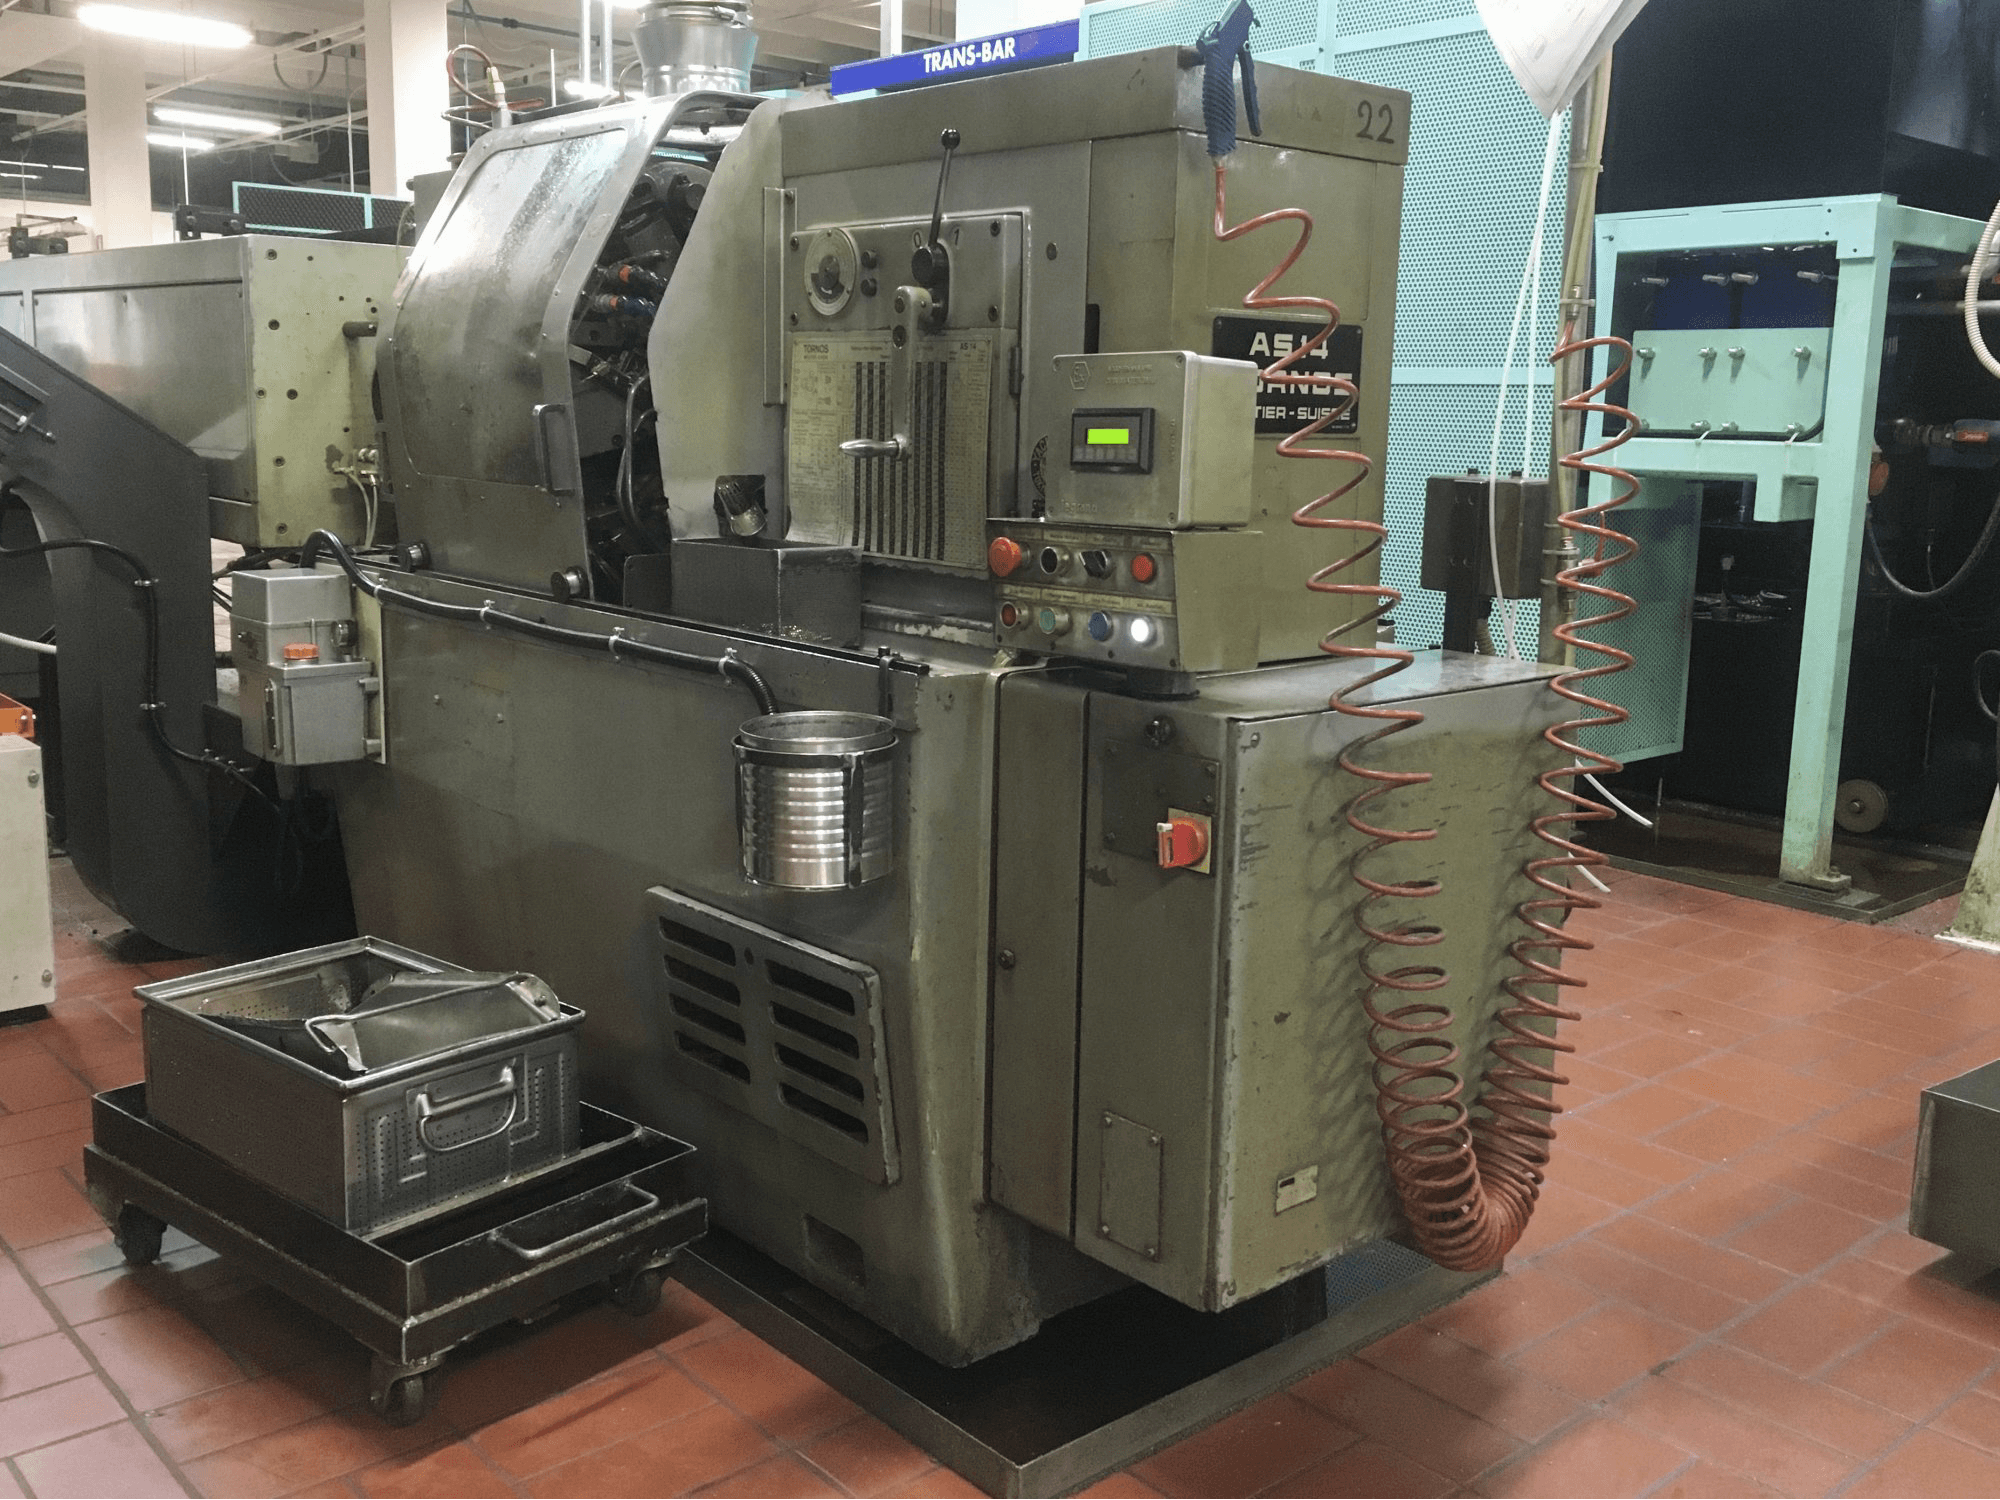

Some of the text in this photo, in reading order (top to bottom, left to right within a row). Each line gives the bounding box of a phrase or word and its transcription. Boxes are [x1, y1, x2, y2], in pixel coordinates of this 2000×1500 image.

[923, 36, 1016, 73] TRANS-BAR
[1356, 100, 1395, 144] 22
[1255, 406, 1286, 419] TIER
